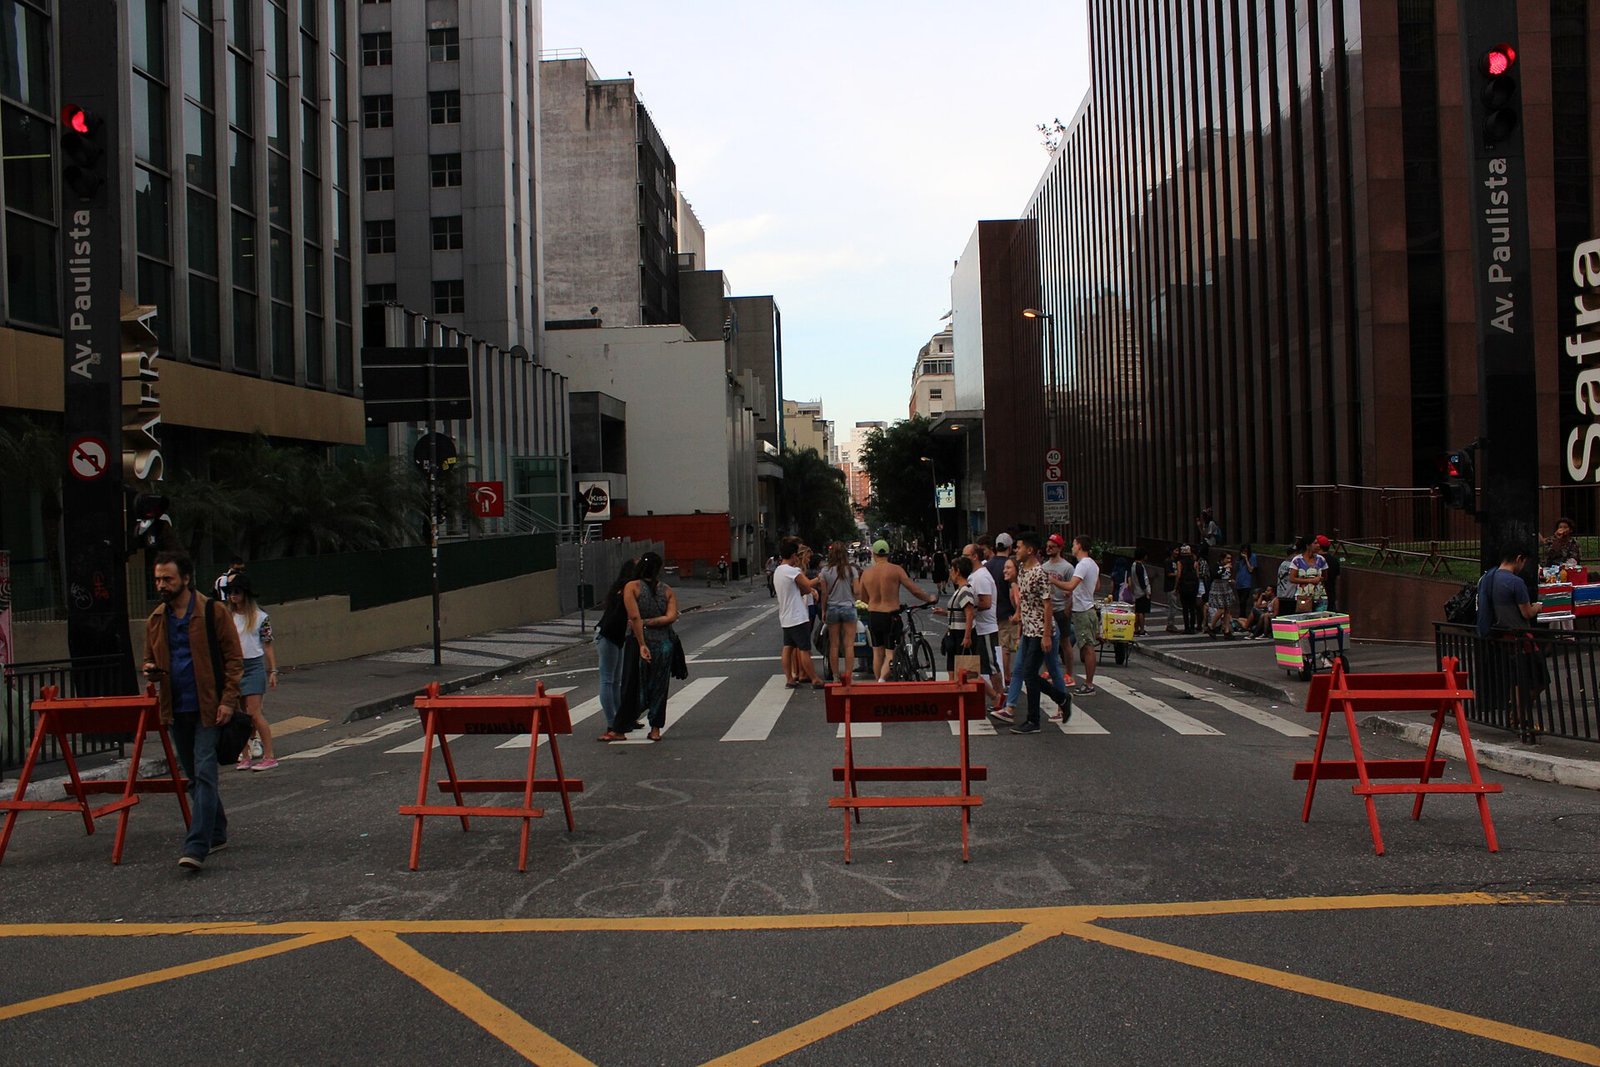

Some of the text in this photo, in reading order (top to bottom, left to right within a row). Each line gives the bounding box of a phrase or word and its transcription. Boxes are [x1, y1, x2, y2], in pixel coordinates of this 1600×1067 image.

[69, 208, 92, 380] Av. Paulista
[1484, 157, 1515, 335] Av. Paulista
[131, 304, 163, 482] SAFRA
[1047, 452, 1060, 461] 40
[873, 701, 939, 717] EXPANSÃO
